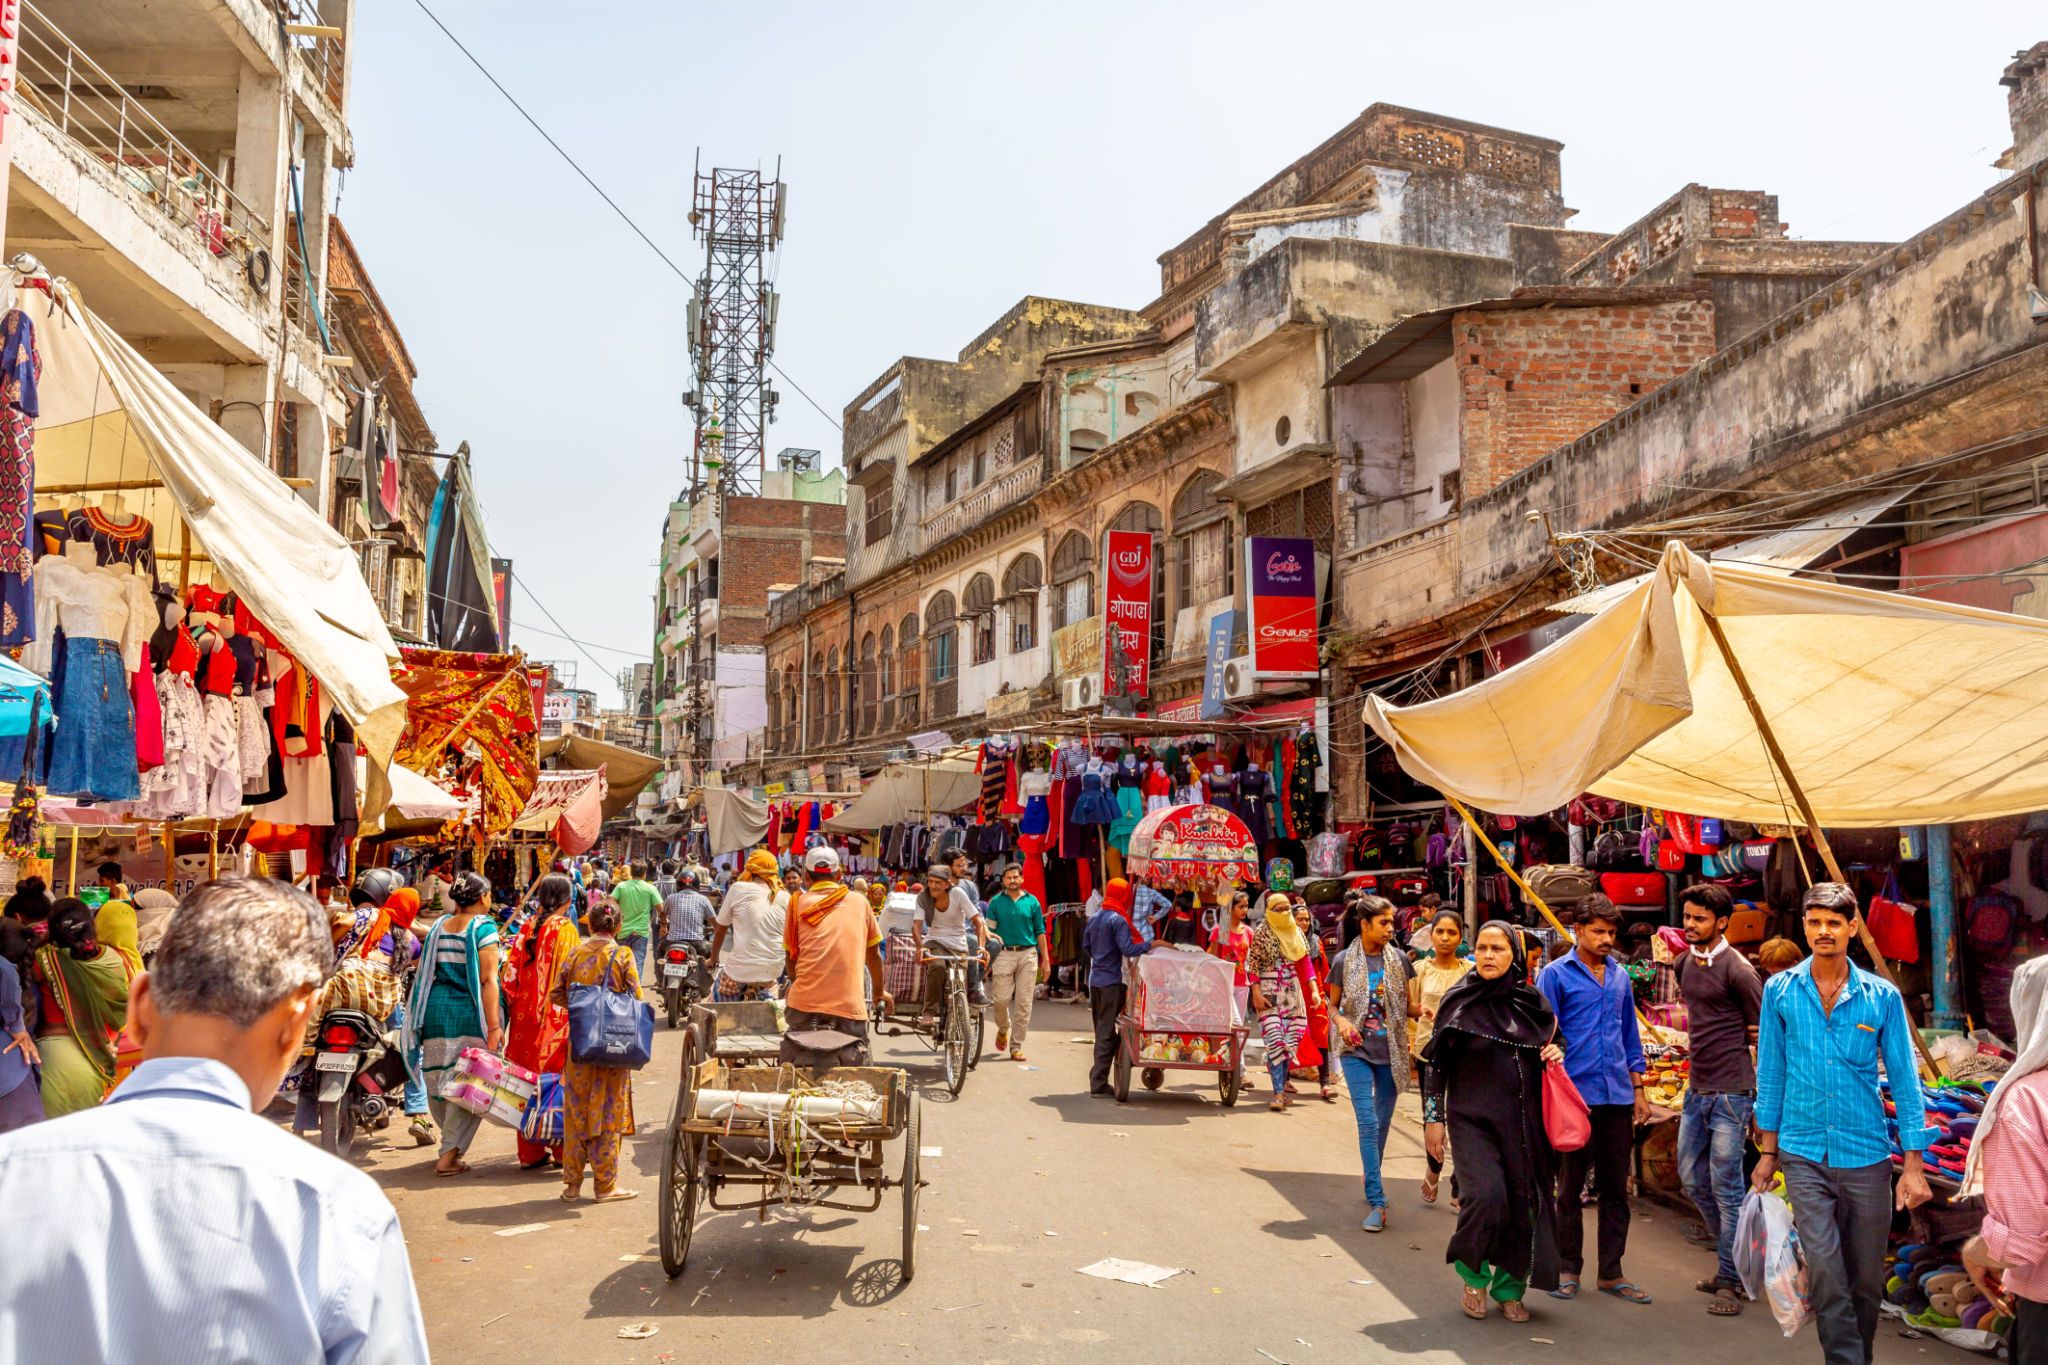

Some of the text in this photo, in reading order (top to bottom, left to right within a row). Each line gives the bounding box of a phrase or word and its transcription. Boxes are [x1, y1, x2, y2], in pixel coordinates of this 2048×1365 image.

[1110, 593, 1148, 620] गोपाल
[1545, 628, 1559, 645] THE
[1212, 630, 1227, 700] safari
[1180, 822, 1239, 846] Kwality
[1746, 845, 1769, 857] TOMMY
